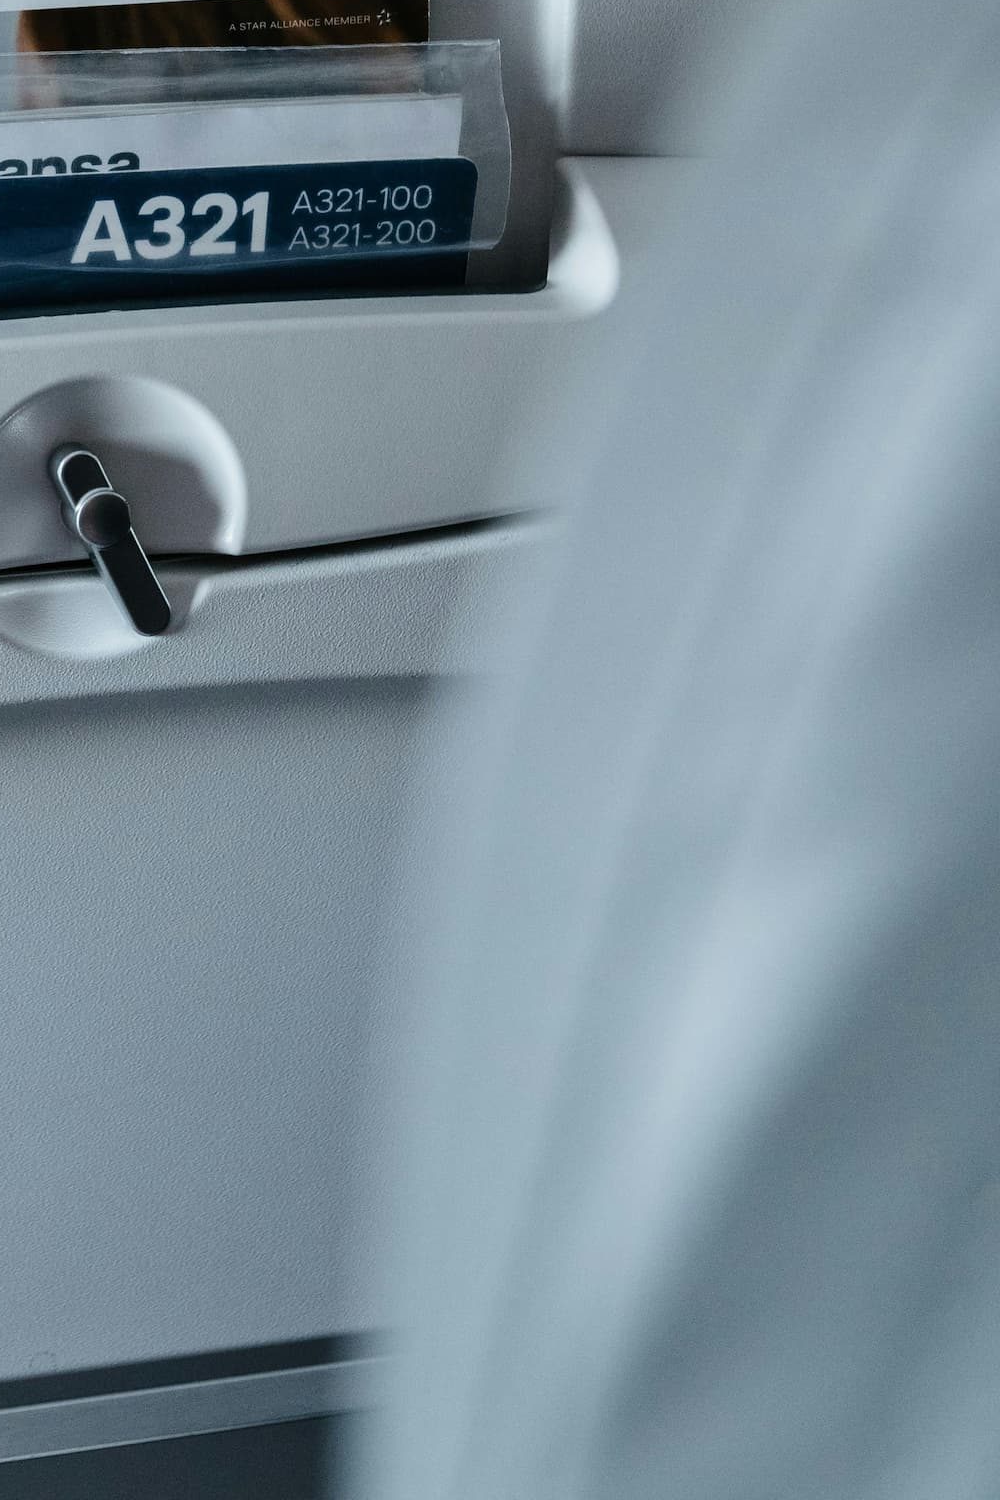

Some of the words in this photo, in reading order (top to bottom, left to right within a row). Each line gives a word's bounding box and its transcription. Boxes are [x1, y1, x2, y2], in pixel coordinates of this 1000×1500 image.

[229, 23, 236, 31] A
[239, 21, 267, 31] STAR
[270, 18, 321, 29] ALLIANCE
[324, 15, 371, 27] MEMBER
[292, 184, 433, 215] A321-100
[70, 191, 270, 264] A321
[288, 219, 436, 252] A321-200
